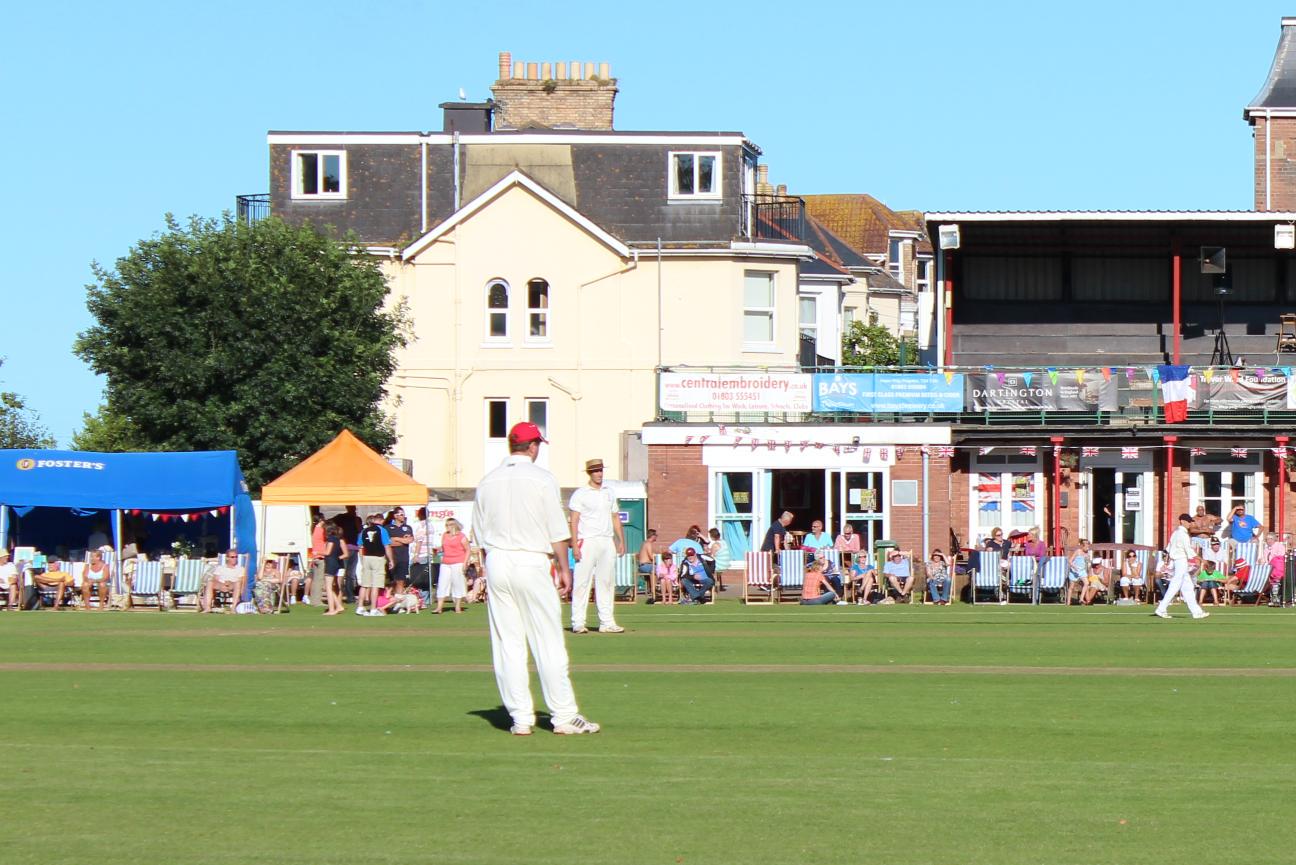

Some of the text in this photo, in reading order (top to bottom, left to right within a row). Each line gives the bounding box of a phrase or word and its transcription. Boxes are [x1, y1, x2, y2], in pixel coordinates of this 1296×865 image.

[819, 382, 857, 396] BAYS
[972, 389, 1053, 398] DARTINGTON
[712, 392, 760, 400] 01803 555451
[37, 459, 106, 470] FOSTER'S
